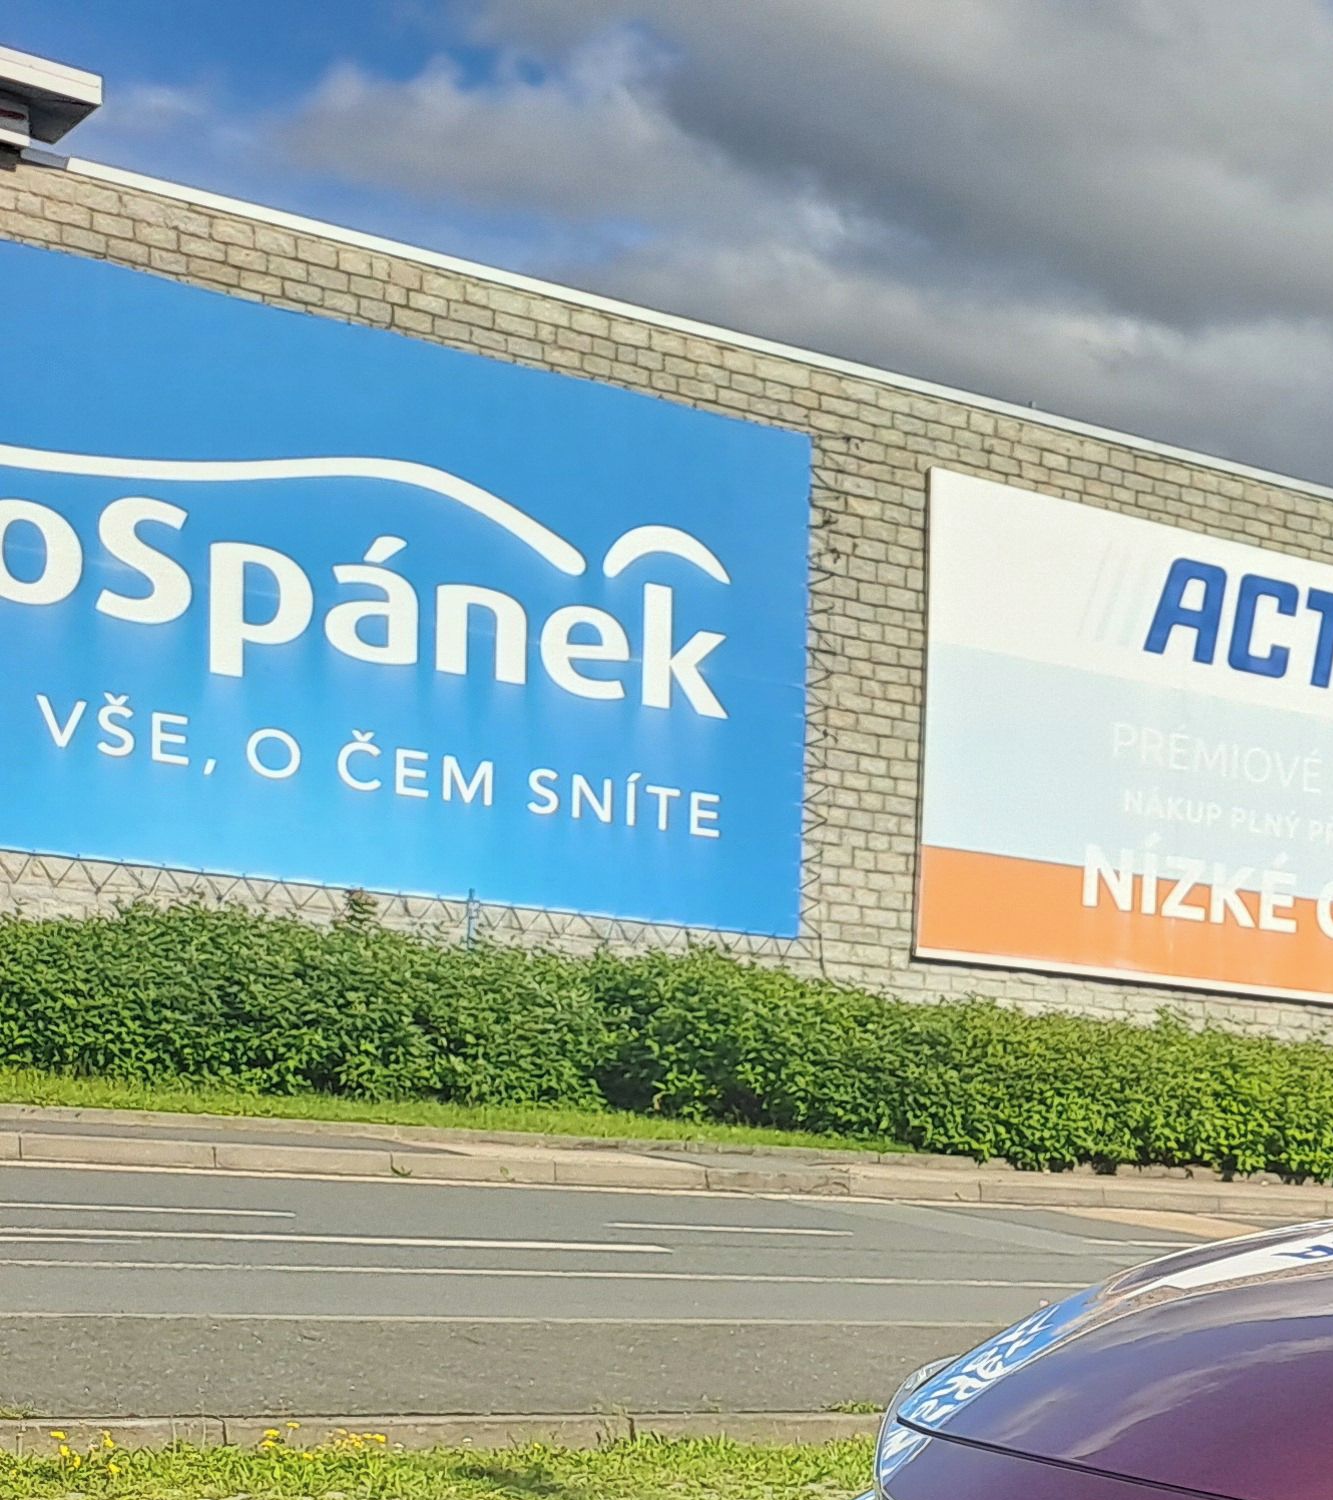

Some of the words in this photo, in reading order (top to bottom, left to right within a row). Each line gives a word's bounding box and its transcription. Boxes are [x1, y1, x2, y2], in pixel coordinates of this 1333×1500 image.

[36, 692, 216, 776] VŠE,
[246, 727, 302, 780] O
[337, 729, 496, 807] ČEM
[527, 767, 722, 839] SNÍTE
[1112, 721, 1322, 795] PRÉMIOVÉ
[1124, 786, 1223, 827] NÁKUP
[1231, 806, 1301, 841] PLNÝ
[1082, 832, 1298, 934] NÍZKÉ
